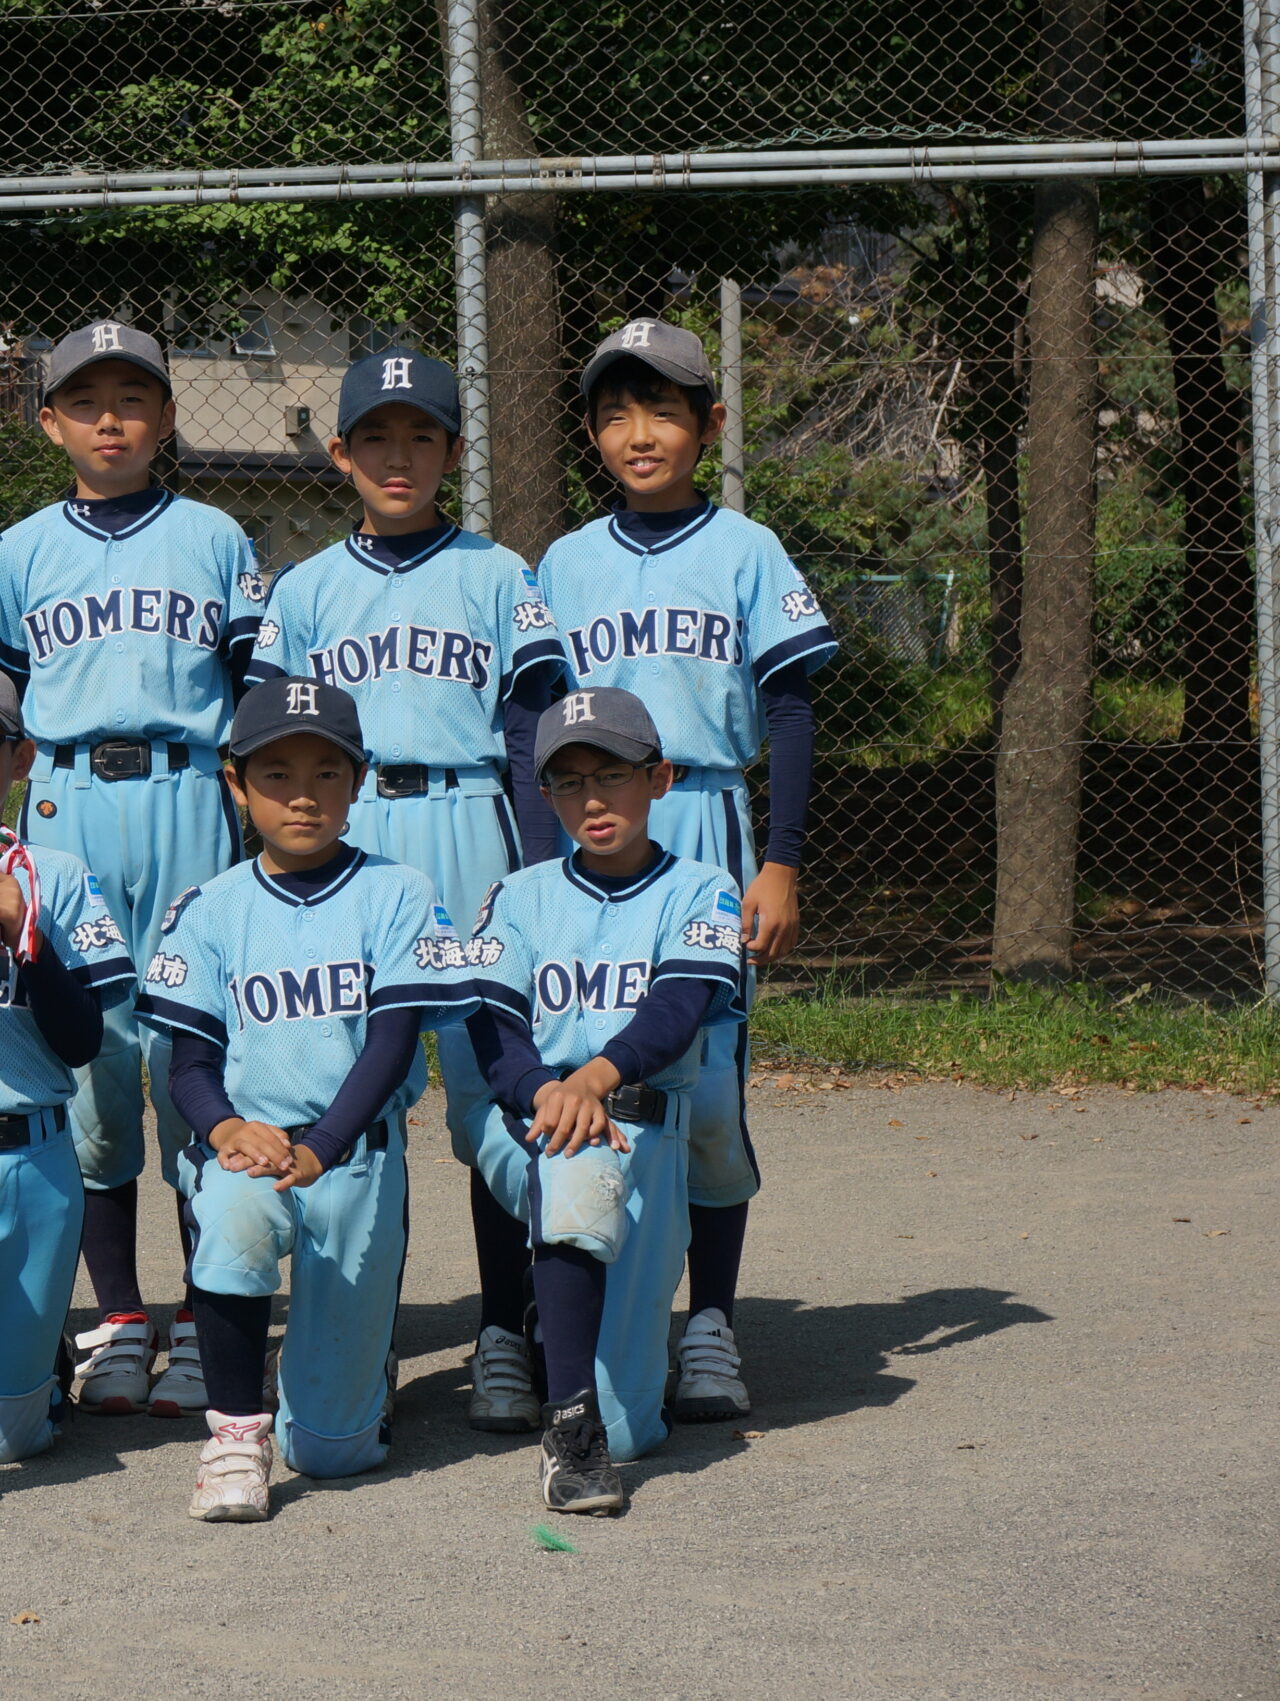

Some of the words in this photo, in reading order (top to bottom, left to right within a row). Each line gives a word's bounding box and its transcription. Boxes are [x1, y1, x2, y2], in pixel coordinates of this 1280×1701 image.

[92, 325, 123, 353] H
[621, 322, 656, 347] H
[381, 357, 413, 391] H
[22, 588, 224, 661] HOMERS
[287, 683, 319, 715] H
[563, 693, 596, 726] H
[228, 959, 366, 1033] OME
[532, 959, 649, 1026] OME
